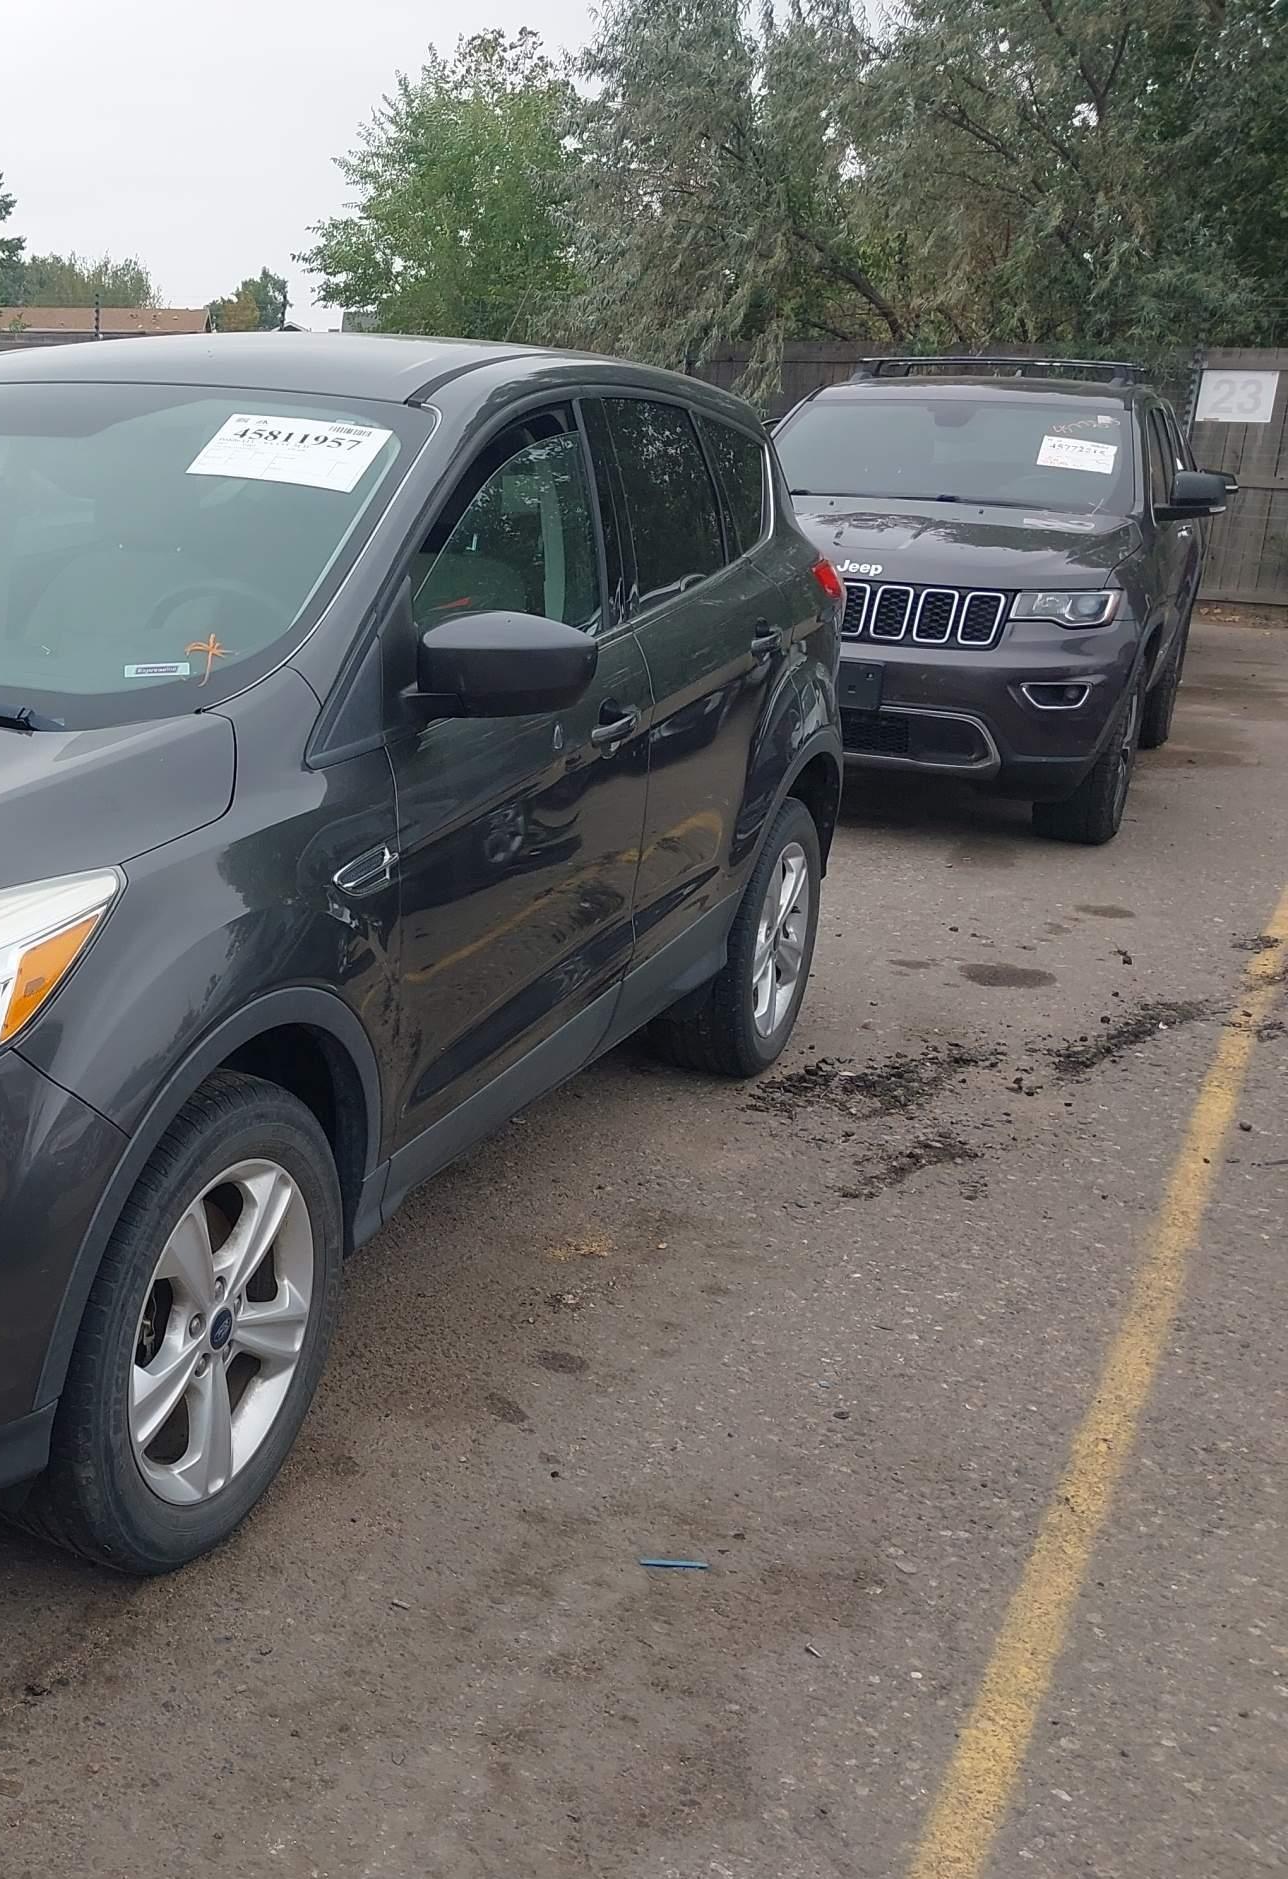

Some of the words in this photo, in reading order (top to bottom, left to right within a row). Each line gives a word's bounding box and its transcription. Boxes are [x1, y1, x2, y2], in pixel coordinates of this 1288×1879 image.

[1207, 378, 1263, 414] 23
[233, 427, 363, 451] 45811957
[836, 559, 883, 577] Jeep
